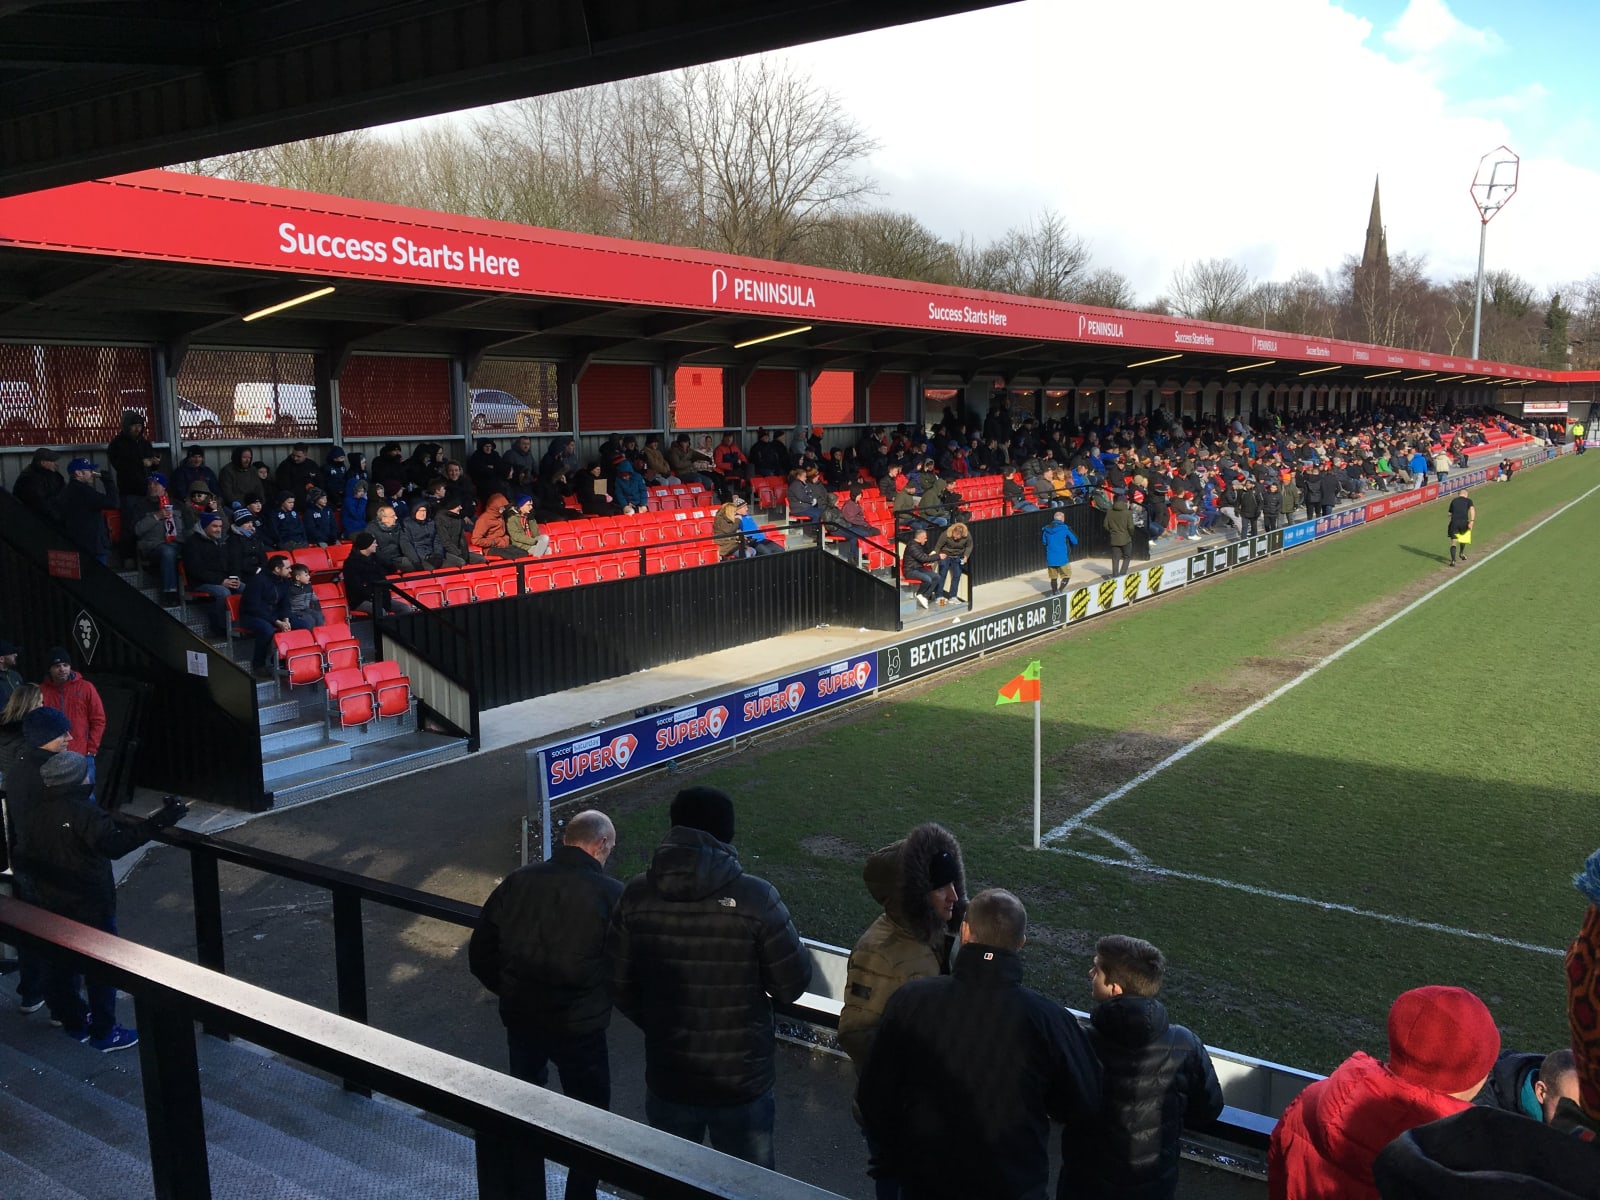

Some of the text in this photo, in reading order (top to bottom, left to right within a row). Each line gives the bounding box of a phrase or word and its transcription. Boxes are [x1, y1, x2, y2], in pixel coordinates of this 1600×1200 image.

[278, 222, 520, 278] Success Starts Here
[734, 278, 816, 308] PENINSULA
[928, 302, 1008, 326] Success Starts Here
[1087, 320, 1124, 338] PENINSULA
[1174, 330, 1192, 344] Success
[909, 606, 1047, 668] BEXTERS KITCHEN & BAR
[656, 715, 674, 726] soccer
[551, 737, 600, 758] soccer saturday
